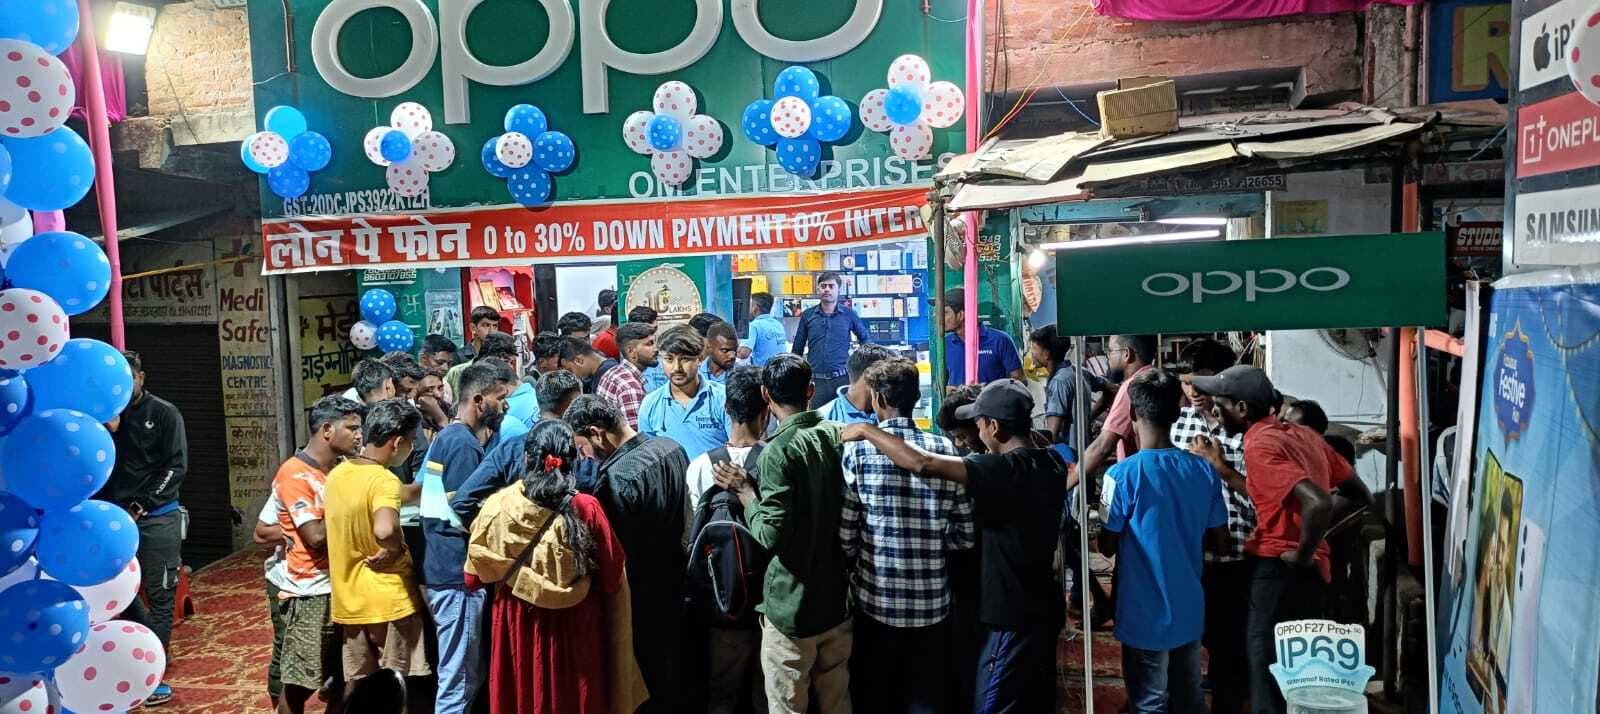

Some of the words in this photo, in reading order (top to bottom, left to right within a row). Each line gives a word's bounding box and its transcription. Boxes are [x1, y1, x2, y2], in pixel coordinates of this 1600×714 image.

[1554, 19, 1576, 61] iP
[267, 222, 344, 268] लोन
[351, 217, 382, 262] पे
[388, 215, 470, 260] फोन
[483, 225, 498, 255] 0
[504, 225, 527, 253] to
[534, 221, 586, 253] 30%
[592, 218, 665, 251] DOWN
[672, 211, 786, 248] PAYMENT
[792, 211, 836, 242] 0%
[844, 205, 923, 239] INTER
[1142, 266, 1350, 303] oppo
[220, 288, 264, 312] Medi
[668, 304, 692, 314] LAKHS
[222, 355, 273, 370] DIAGNOSTIC
[226, 376, 268, 389] CENTRE
[1499, 367, 1526, 409] Festive
[1277, 624, 1303, 636] OPPO
[1305, 623, 1325, 633] F27
[1327, 624, 1351, 635] Pro+
[1280, 635, 1359, 670] IP69
